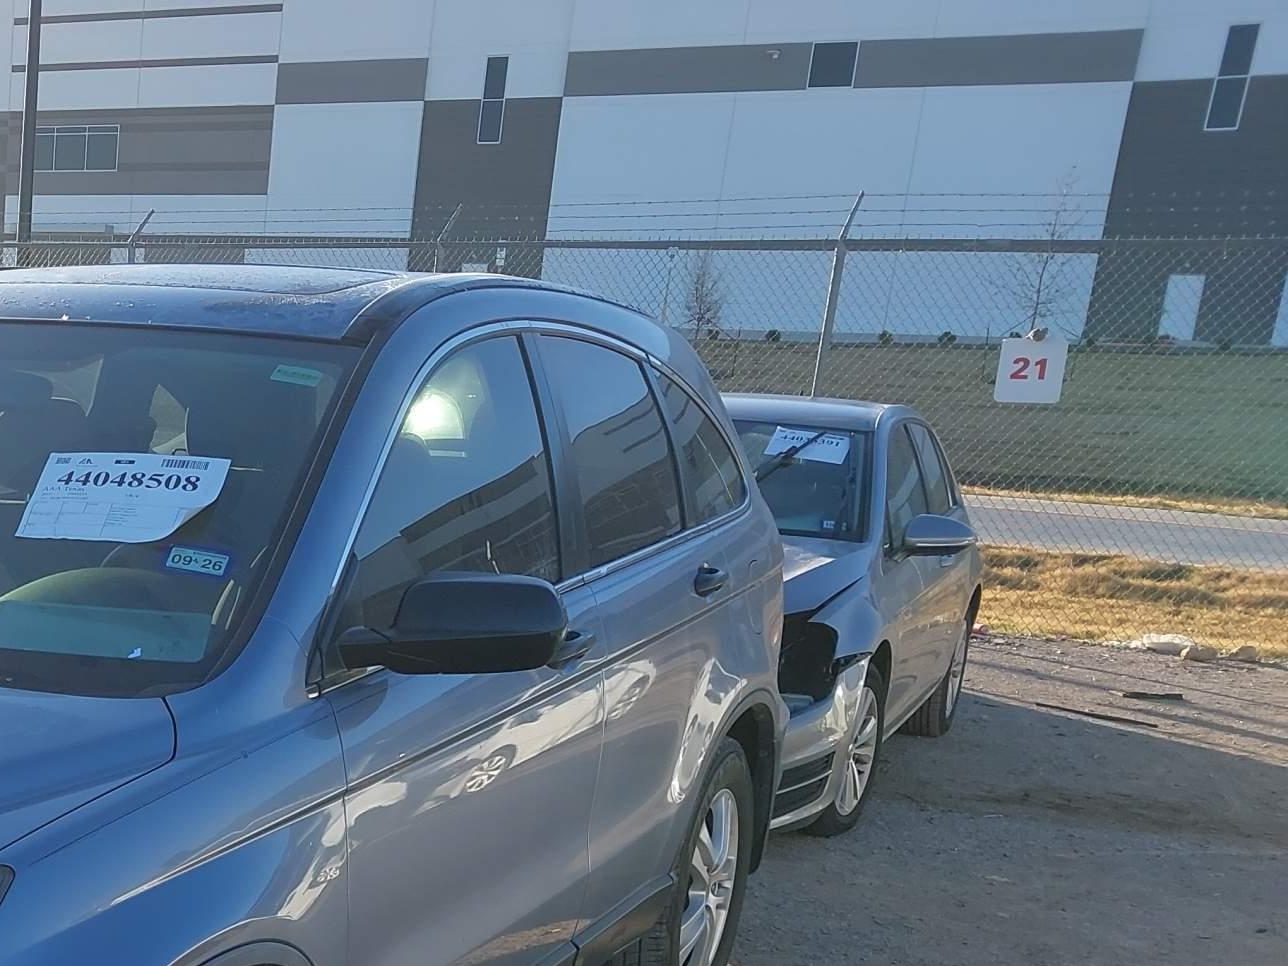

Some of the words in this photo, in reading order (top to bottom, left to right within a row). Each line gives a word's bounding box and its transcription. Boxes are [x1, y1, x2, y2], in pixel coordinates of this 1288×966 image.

[1009, 356, 1048, 380] 21
[57, 470, 201, 492] 44048508
[171, 553, 193, 566] 09
[200, 558, 224, 571] 26
